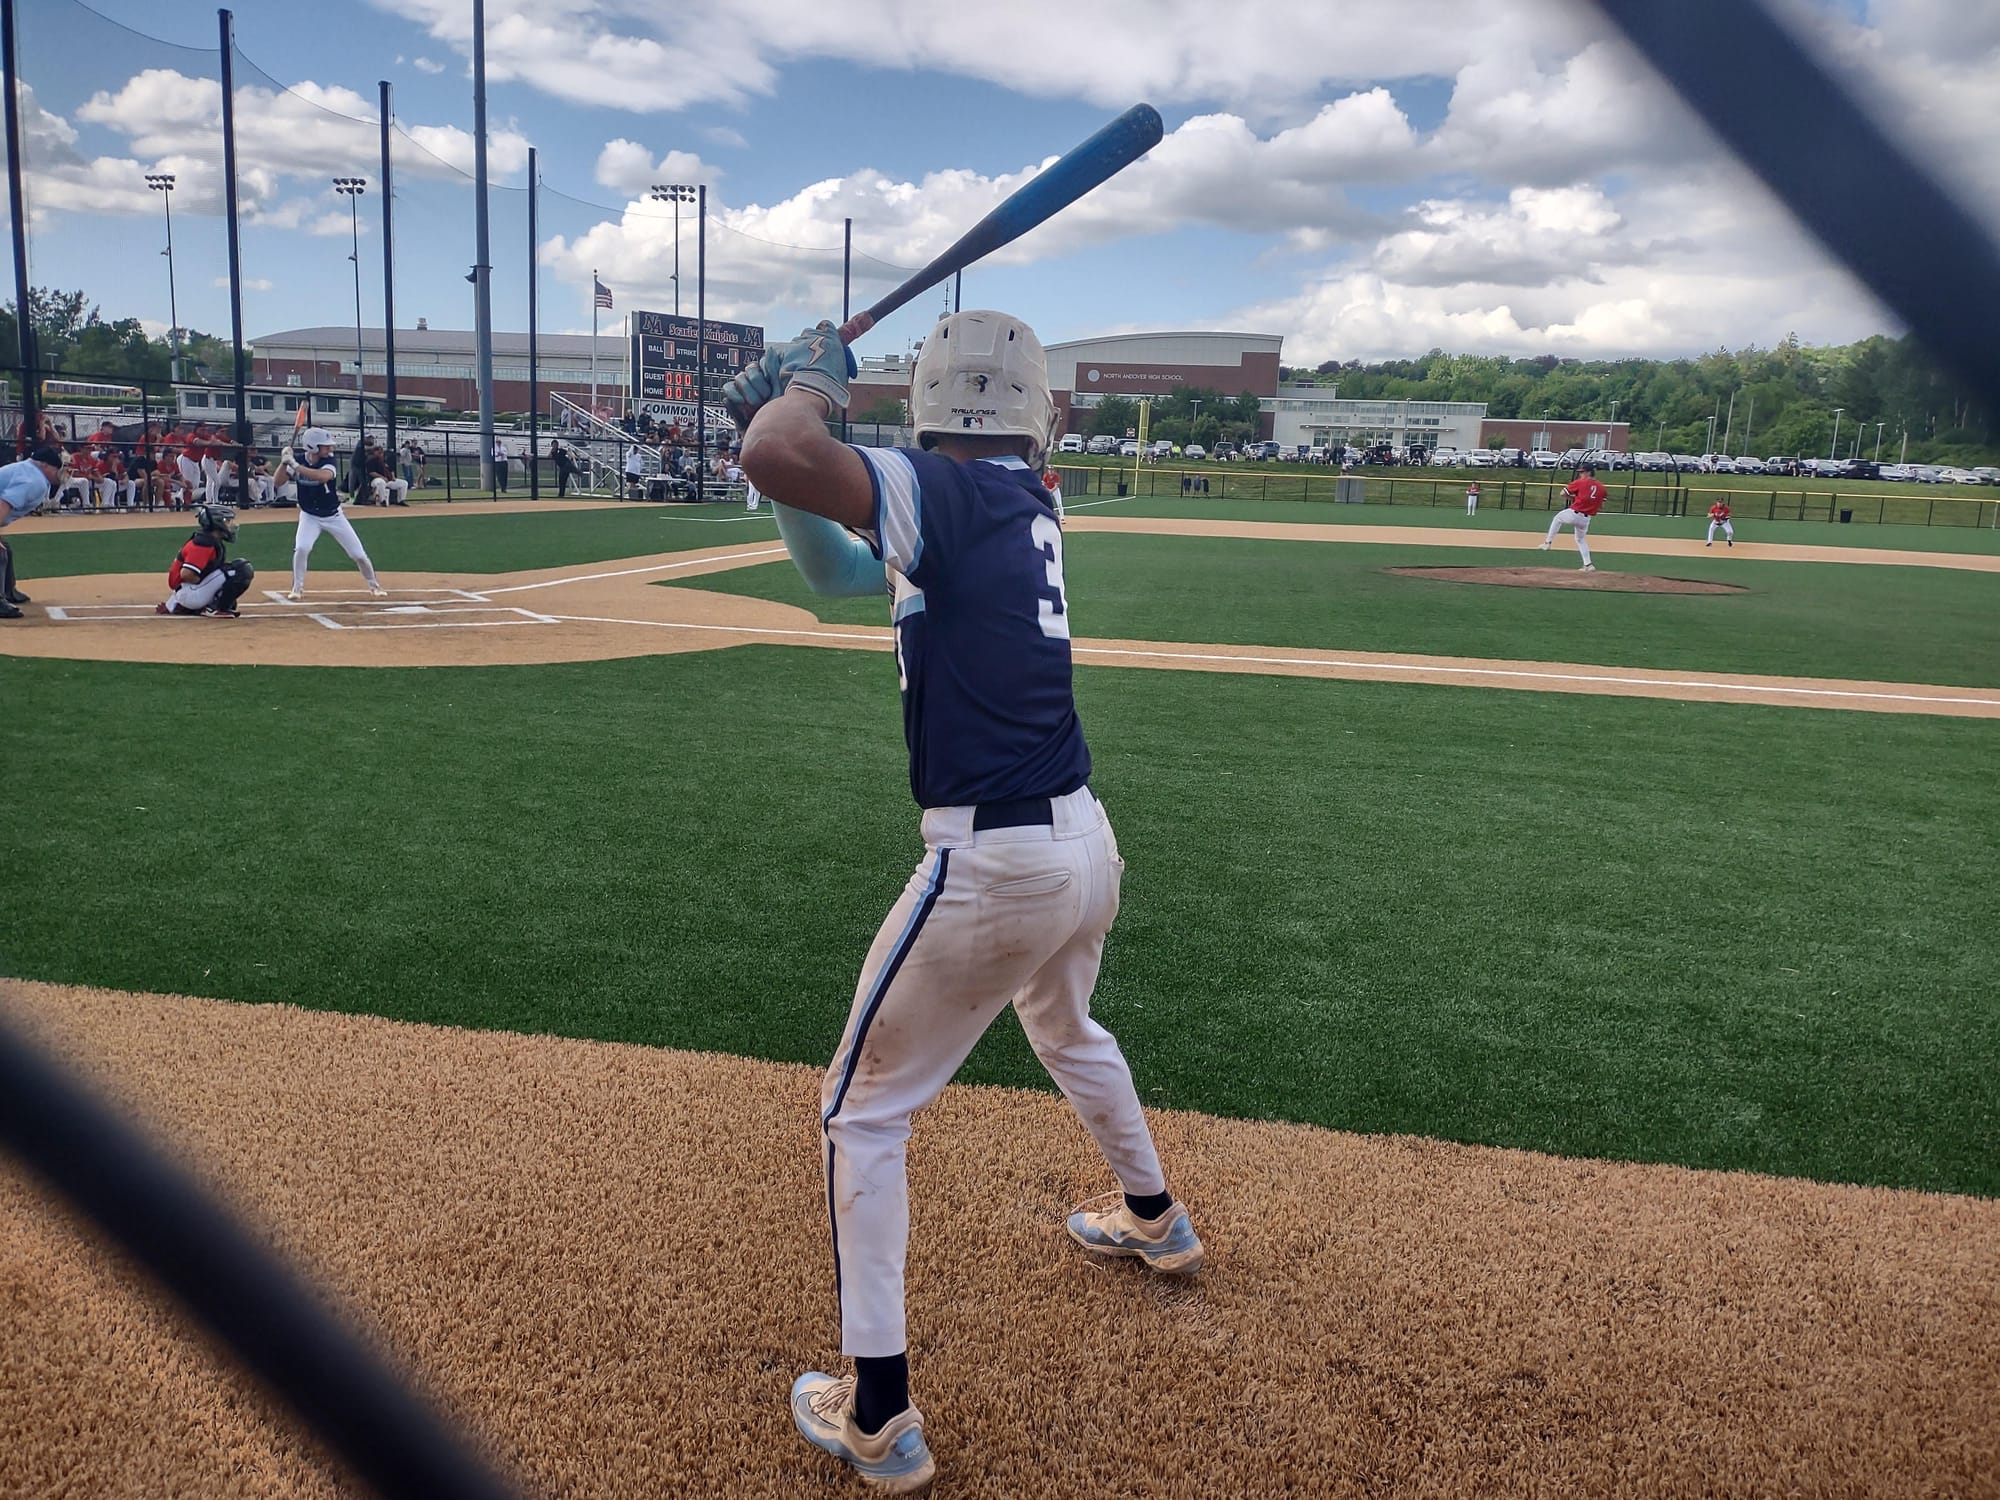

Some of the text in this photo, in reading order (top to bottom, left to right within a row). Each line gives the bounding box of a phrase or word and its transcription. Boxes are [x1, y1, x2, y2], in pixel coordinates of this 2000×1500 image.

[669, 323, 699, 338] Scarle
[703, 328, 738, 343] Knights
[648, 345, 664, 353] BALL
[676, 348, 697, 357] STRIKE
[716, 352, 728, 360] OUT
[644, 372, 665, 381] GUEST
[666, 372, 691, 386] 0 0 0
[644, 386, 664, 395] HOME
[666, 387, 672, 398] 0
[675, 388, 682, 400] 0
[1590, 485, 1597, 499] 2
[1031, 513, 1070, 640] 3
